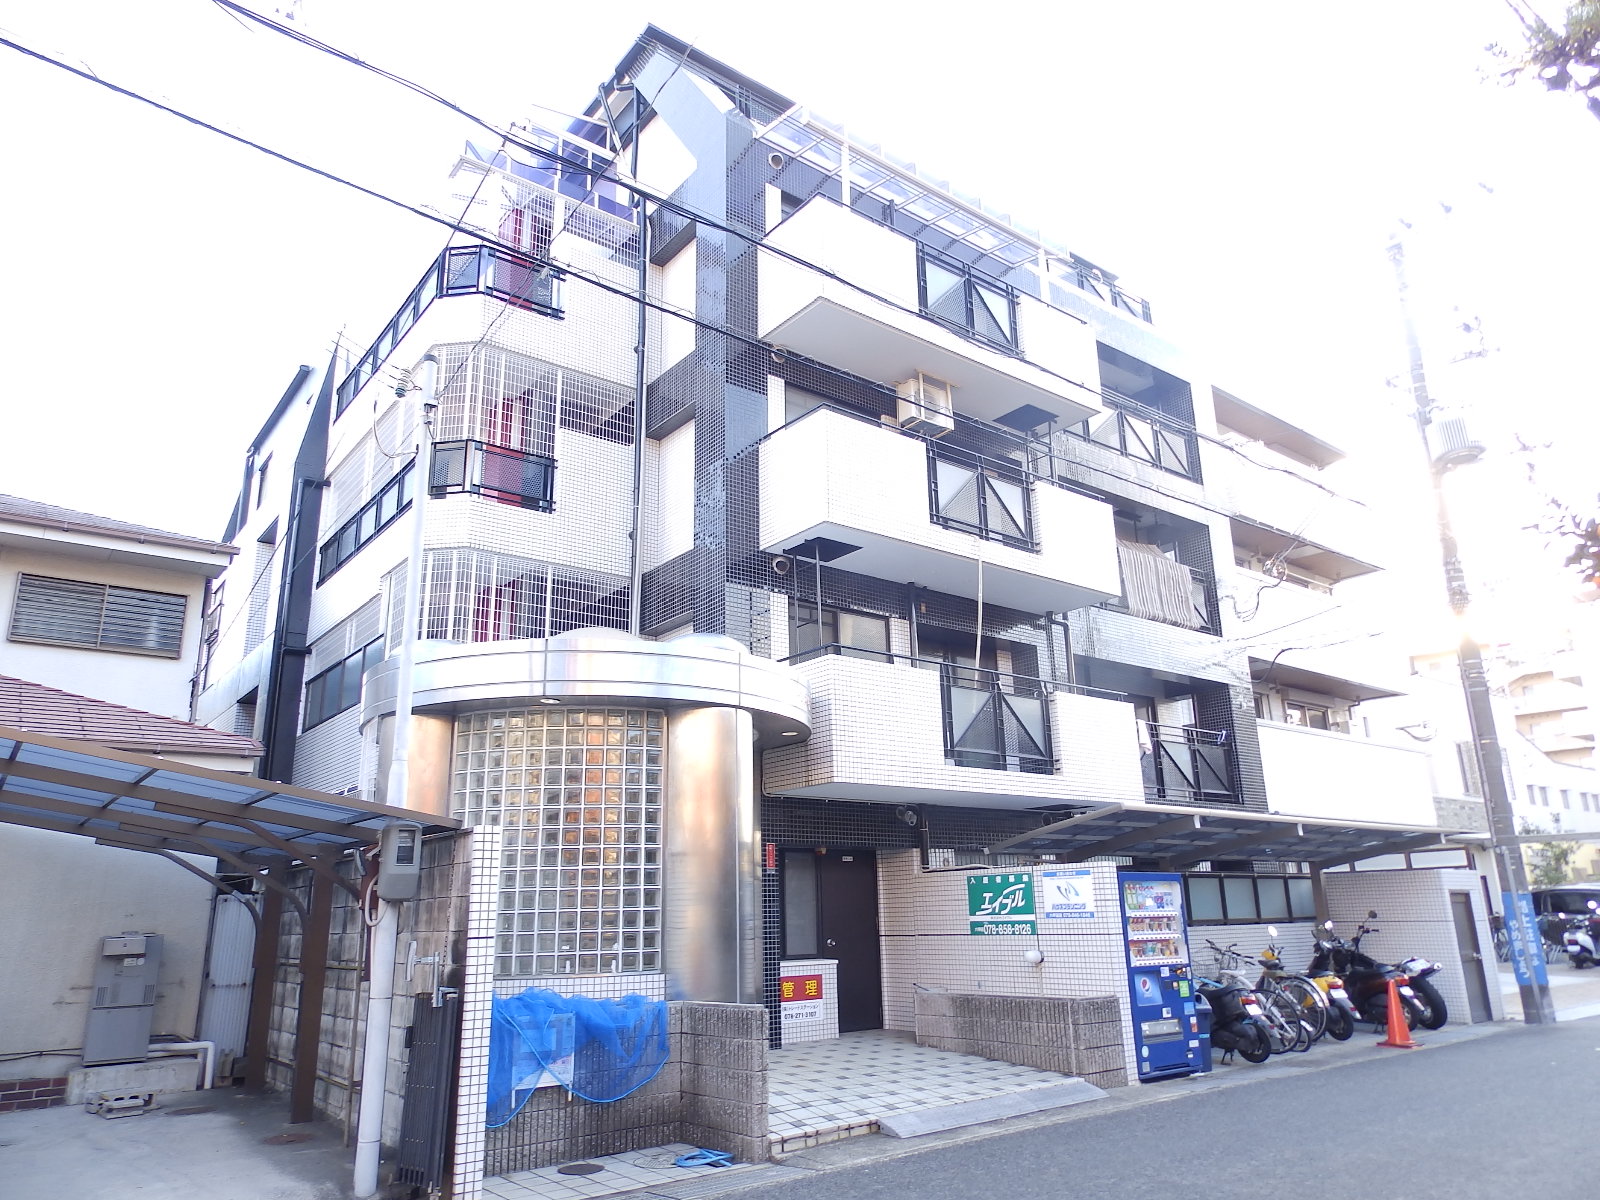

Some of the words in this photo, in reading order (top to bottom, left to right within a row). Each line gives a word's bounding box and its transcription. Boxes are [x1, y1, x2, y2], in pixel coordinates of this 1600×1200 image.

[975, 884, 1026, 915] エイブル
[984, 924, 1032, 934] 078-858-8126
[782, 980, 818, 997] 管理
